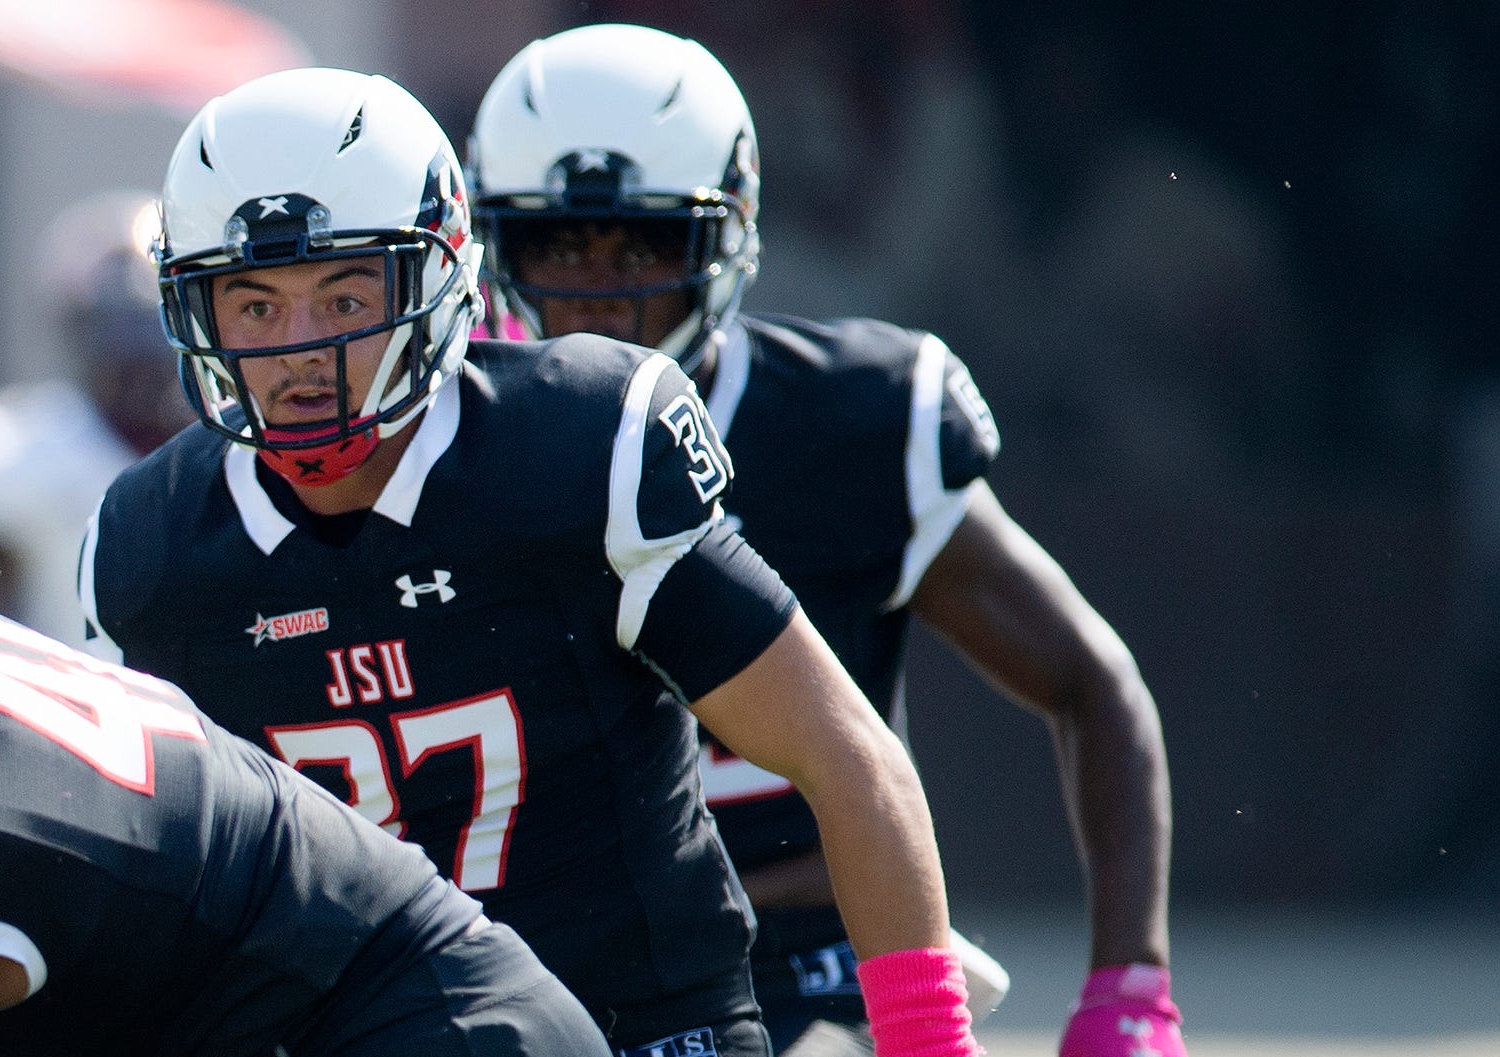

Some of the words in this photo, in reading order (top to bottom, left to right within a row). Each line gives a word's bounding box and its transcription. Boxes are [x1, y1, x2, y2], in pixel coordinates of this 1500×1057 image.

[658, 380, 734, 504] 3
[272, 608, 327, 638] SWAC
[325, 638, 415, 708] JSU
[263, 685, 528, 893] 37
